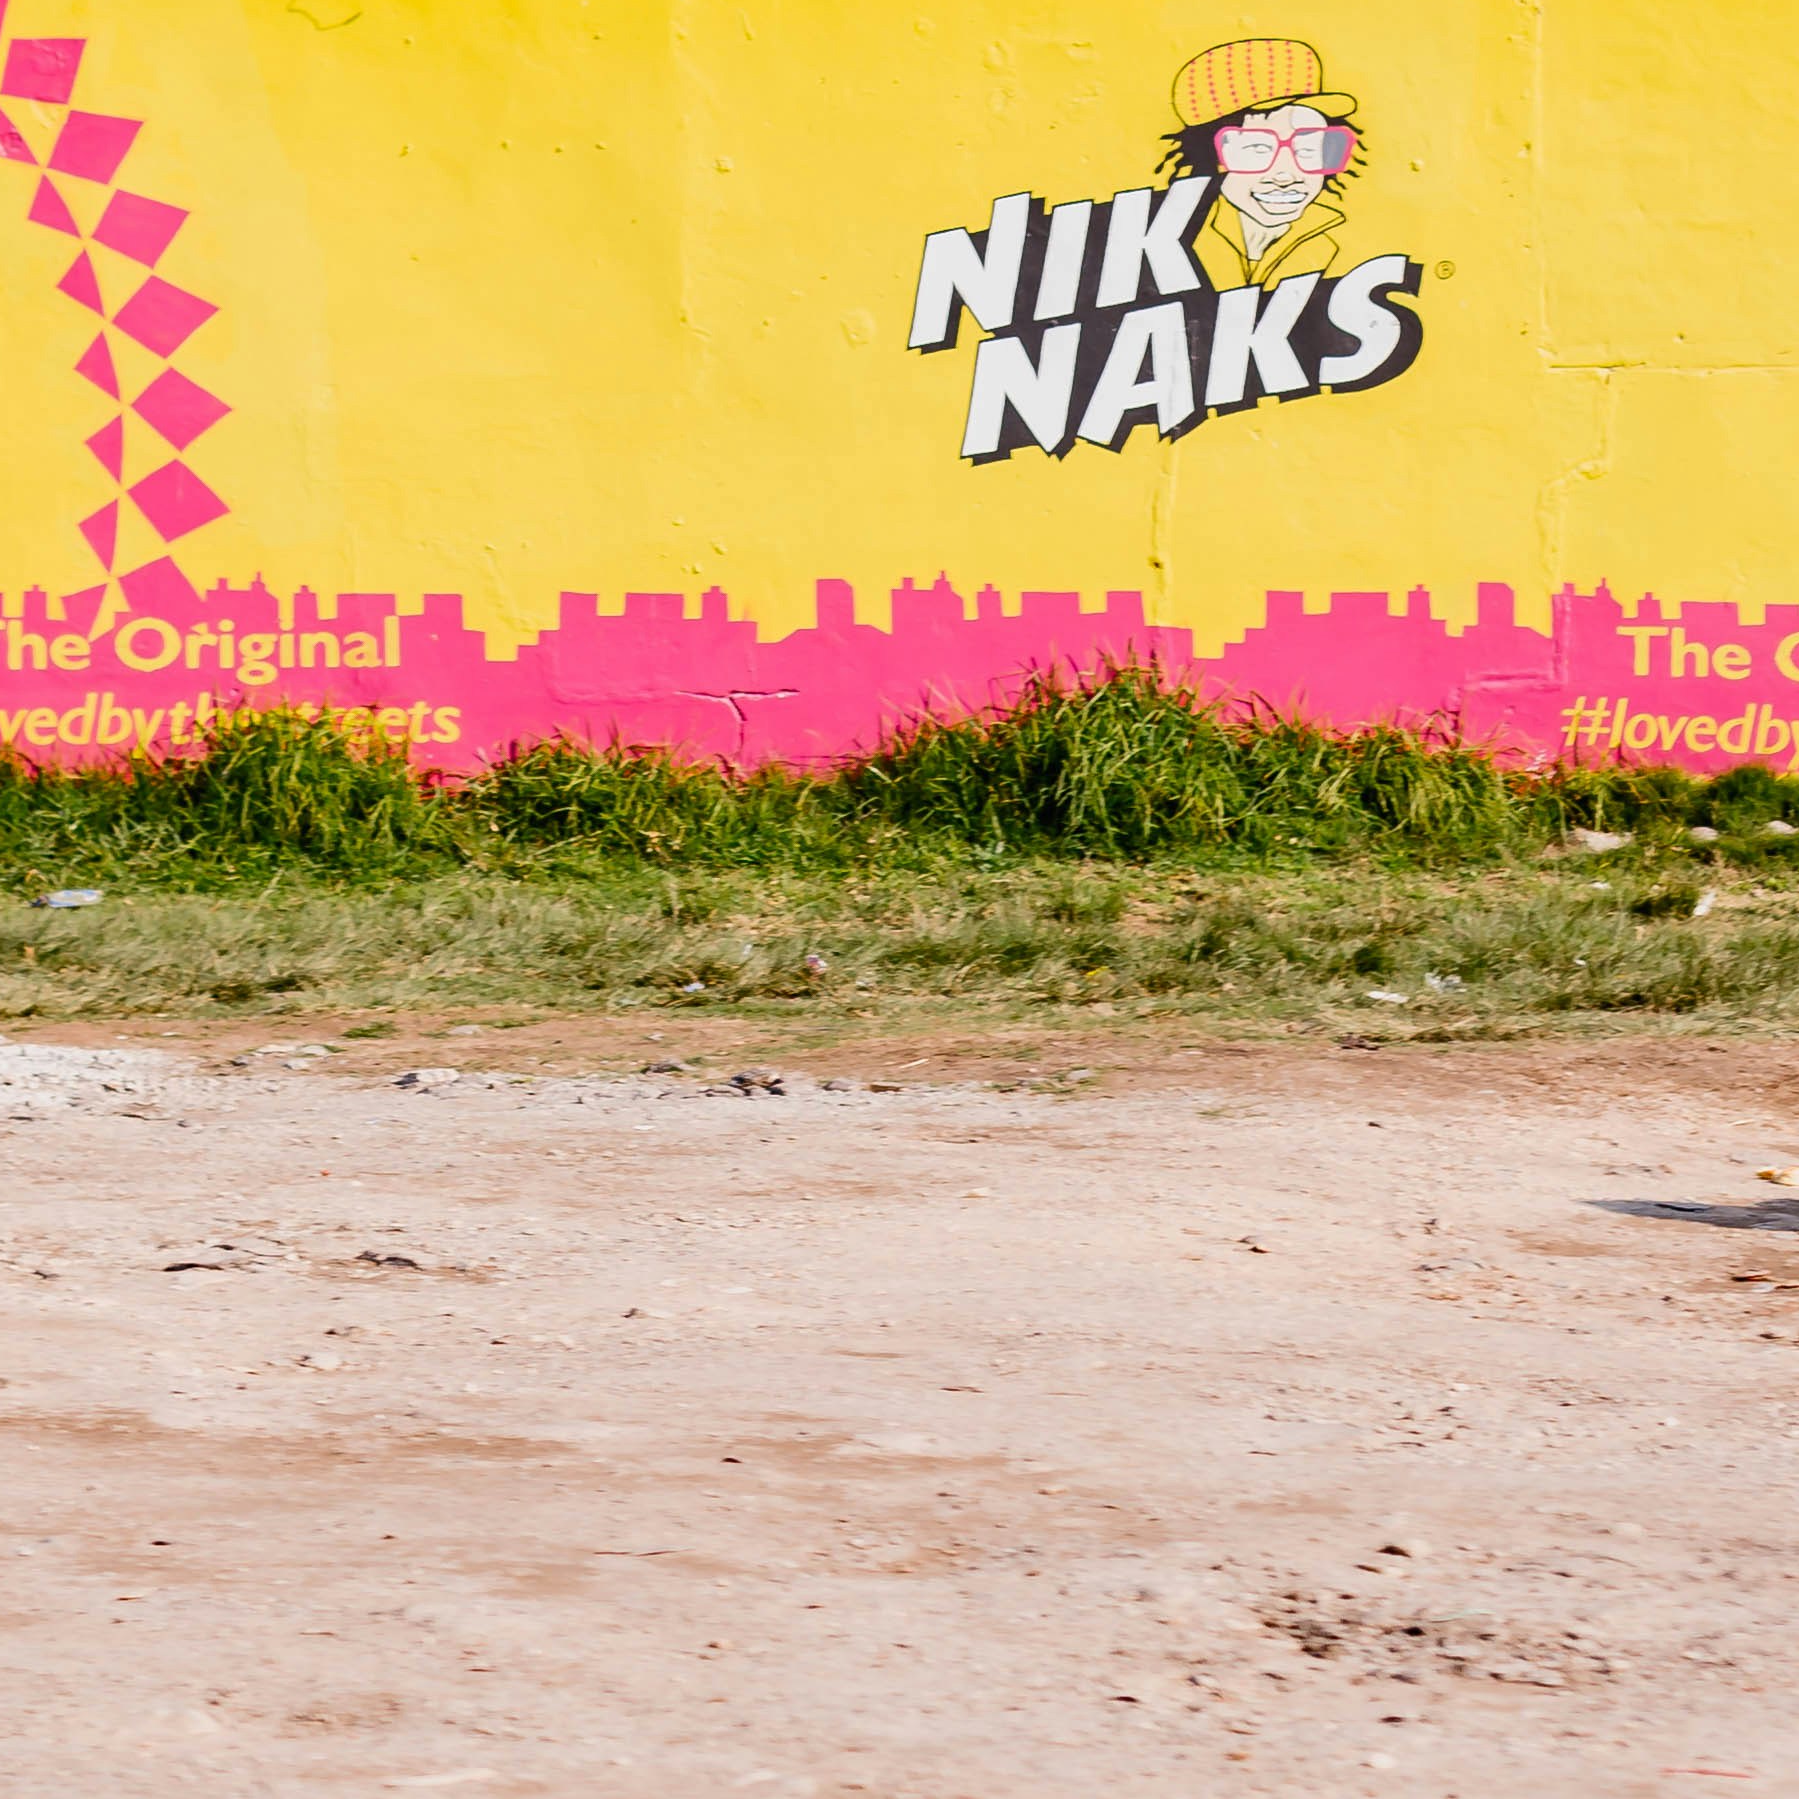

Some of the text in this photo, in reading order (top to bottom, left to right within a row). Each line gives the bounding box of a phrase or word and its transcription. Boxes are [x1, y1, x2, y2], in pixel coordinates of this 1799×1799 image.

[907, 175, 1213, 354] NIK
[960, 254, 1423, 466] NAKS
[115, 614, 400, 685] Original
[1616, 625, 1751, 679] The
